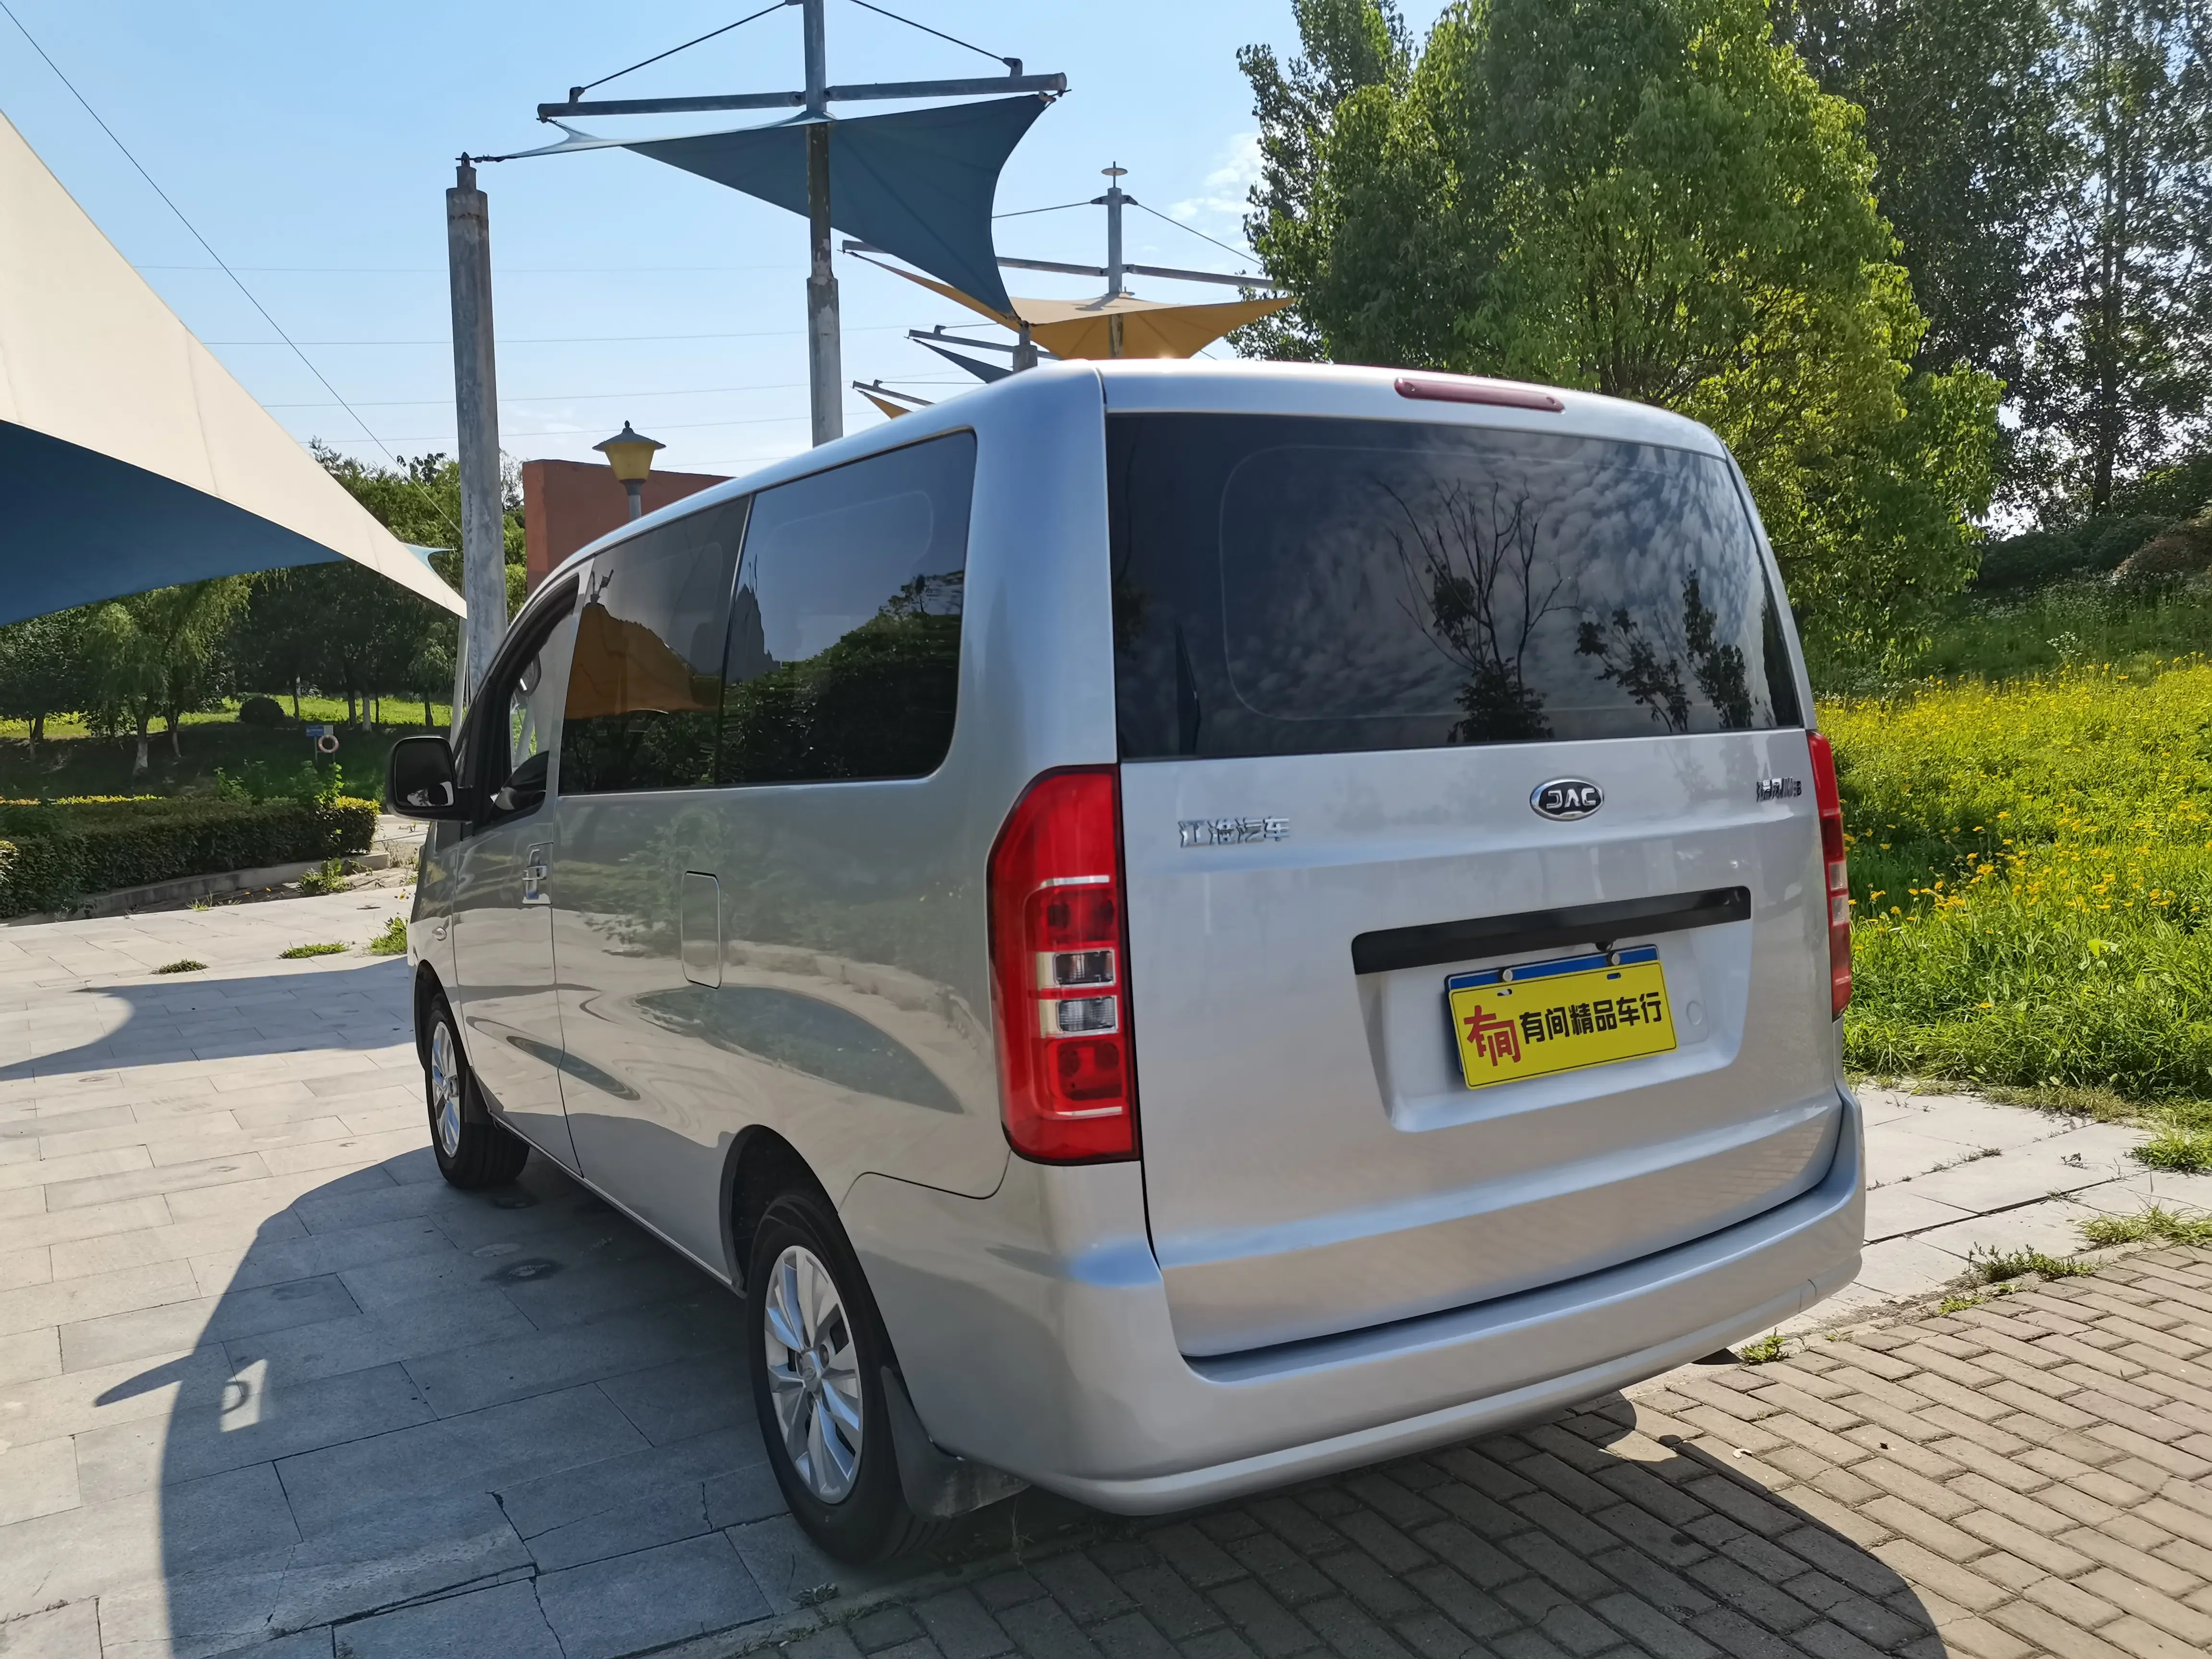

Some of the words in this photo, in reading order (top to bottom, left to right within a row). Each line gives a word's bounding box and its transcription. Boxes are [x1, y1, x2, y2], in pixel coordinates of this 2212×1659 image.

[1546, 788, 1597, 809] JAC
[1178, 816, 1290, 848] 江淮汽车
[1519, 991, 1662, 1045] 有间精品车行
